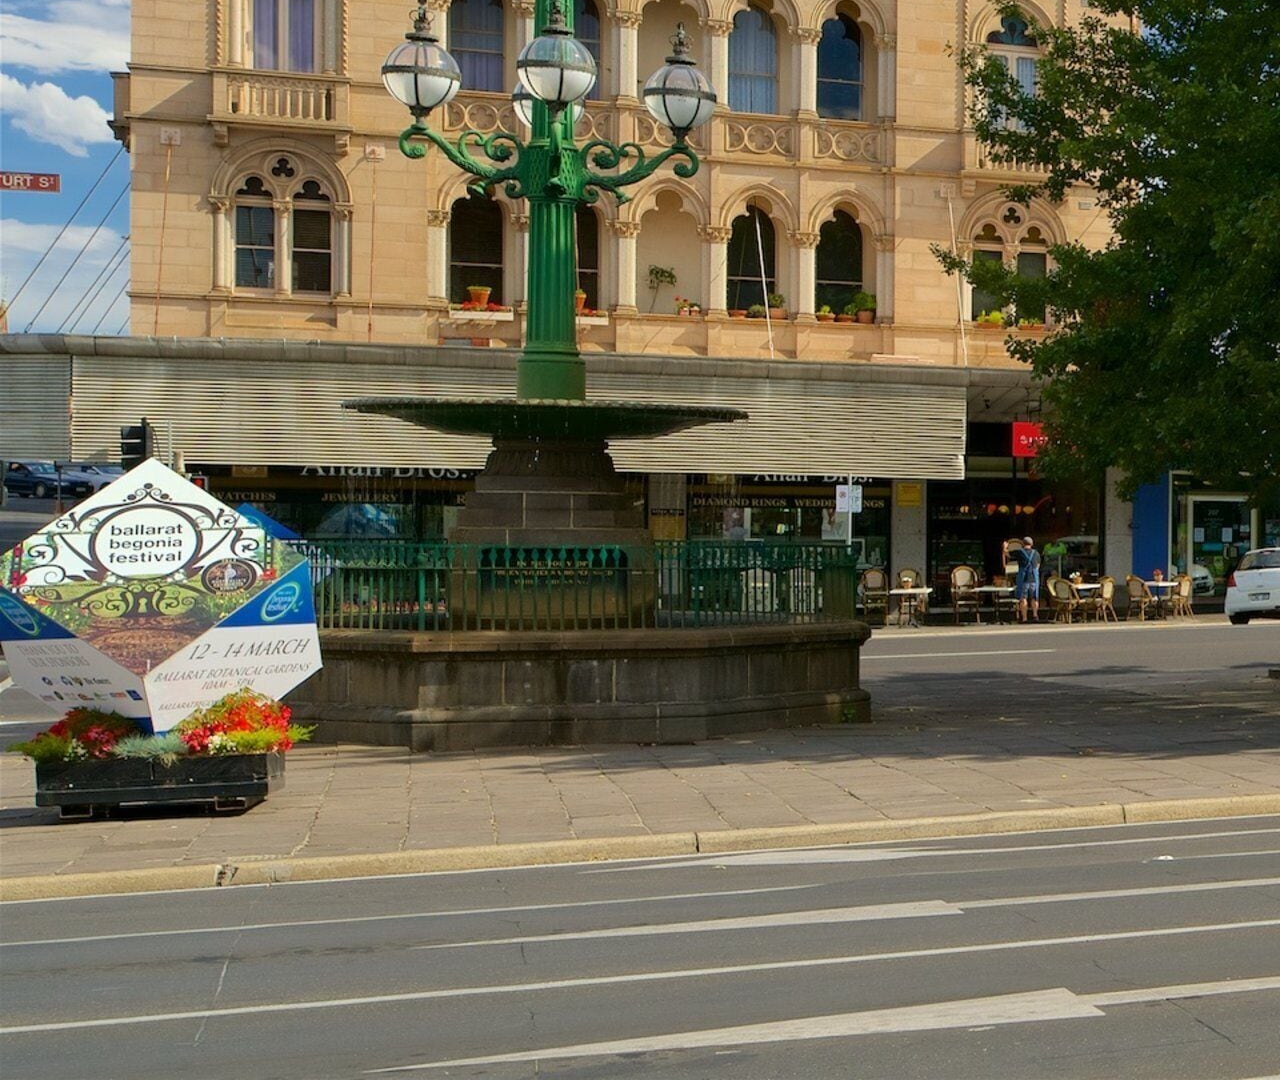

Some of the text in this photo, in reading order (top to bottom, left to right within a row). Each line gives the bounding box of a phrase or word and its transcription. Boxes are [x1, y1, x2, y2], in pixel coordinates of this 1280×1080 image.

[0, 174, 33, 187] URT
[211, 492, 276, 501] WATCHES
[321, 492, 398, 502] JEWELLERY
[693, 497, 749, 507] DIAMOND
[751, 498, 787, 507] RINGS
[111, 524, 184, 536] ballarat
[109, 537, 183, 551] begonia
[109, 551, 182, 563] festival
[188, 643, 211, 660] 12
[224, 642, 243, 658] 14
[244, 638, 311, 656] MARCH
[154, 662, 312, 683] BALLARAT BOTANICAL GARDENS
